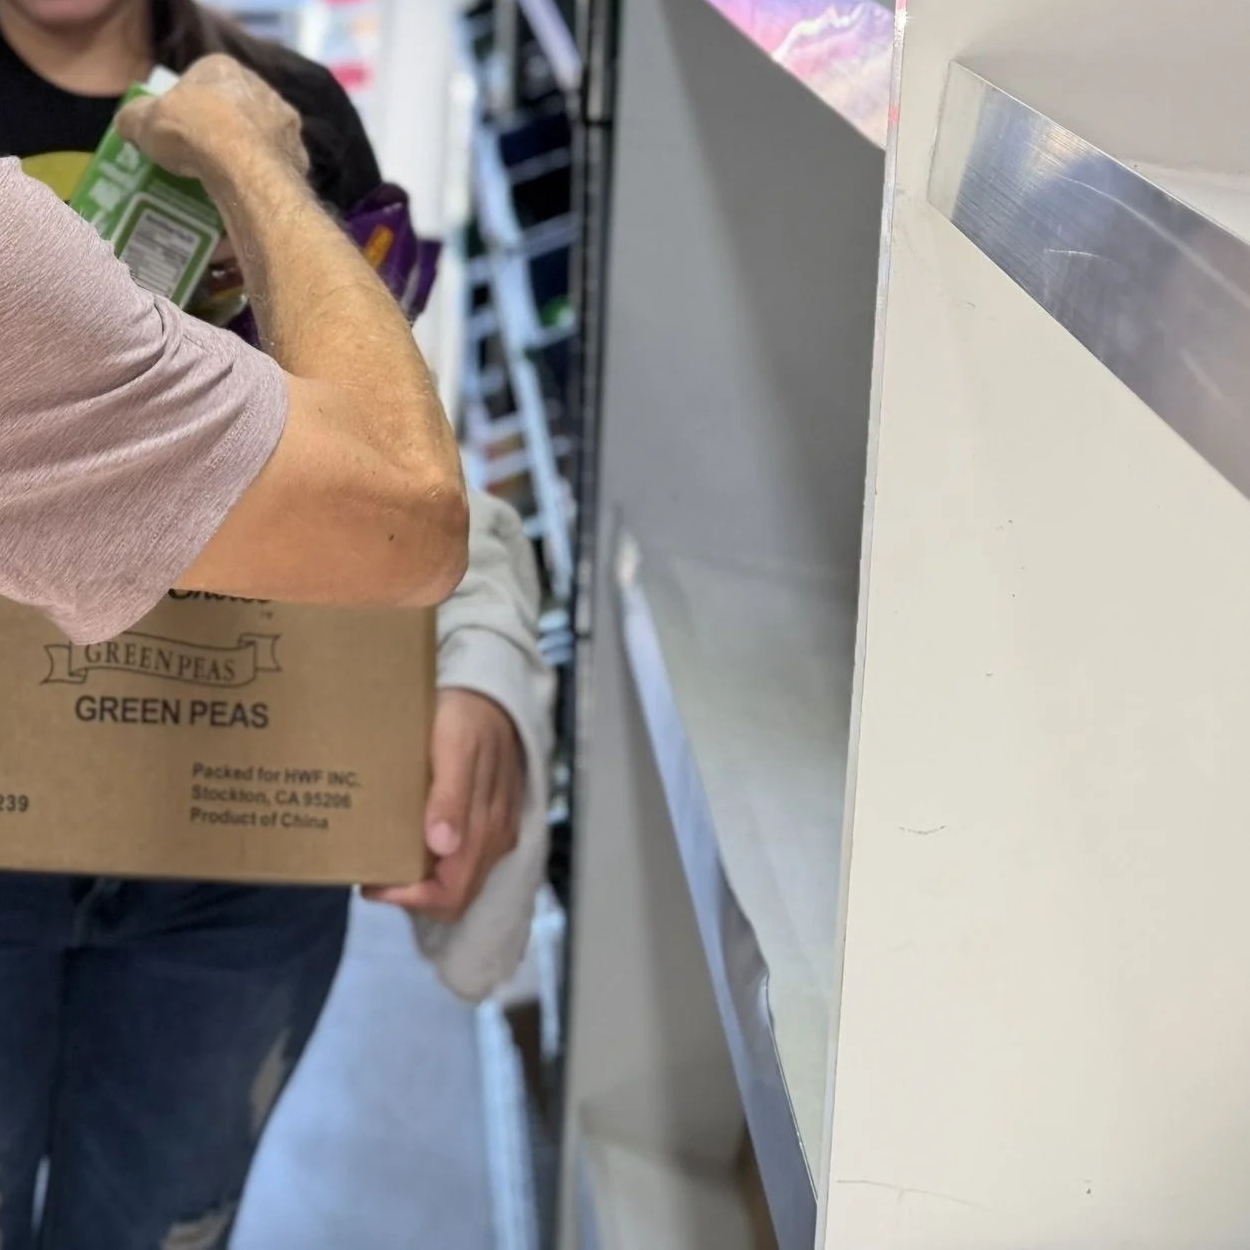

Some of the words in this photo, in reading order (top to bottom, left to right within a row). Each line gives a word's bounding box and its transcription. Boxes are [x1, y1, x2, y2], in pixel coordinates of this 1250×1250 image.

[85, 640, 172, 672] GREEN
[177, 654, 236, 682] PEAS
[75, 694, 180, 726] GREEN
[188, 699, 269, 729] PEAS
[192, 761, 254, 781] Packed
[257, 765, 281, 782] for
[284, 767, 324, 784] HWF
[191, 783, 271, 806] Stockton,
[275, 789, 300, 806] CA
[190, 806, 257, 827] Product
[259, 810, 278, 827] of
[280, 812, 329, 830] China
